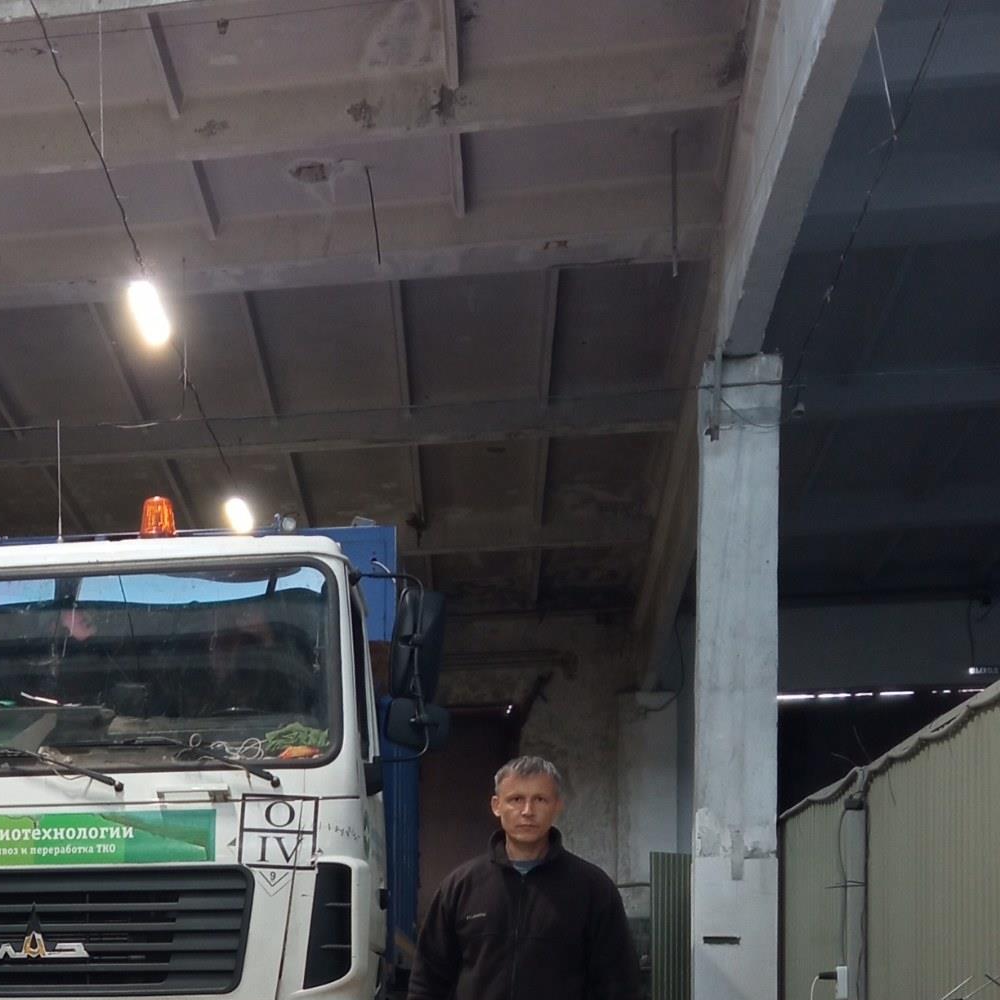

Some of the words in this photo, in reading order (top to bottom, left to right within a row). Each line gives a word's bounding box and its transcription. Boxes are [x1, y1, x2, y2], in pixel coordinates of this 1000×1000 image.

[21, 847, 27, 855] и
[30, 845, 94, 857] переработка
[96, 843, 116, 853] ТКО
[259, 836, 303, 863] IV
[270, 871, 276, 881] 9
